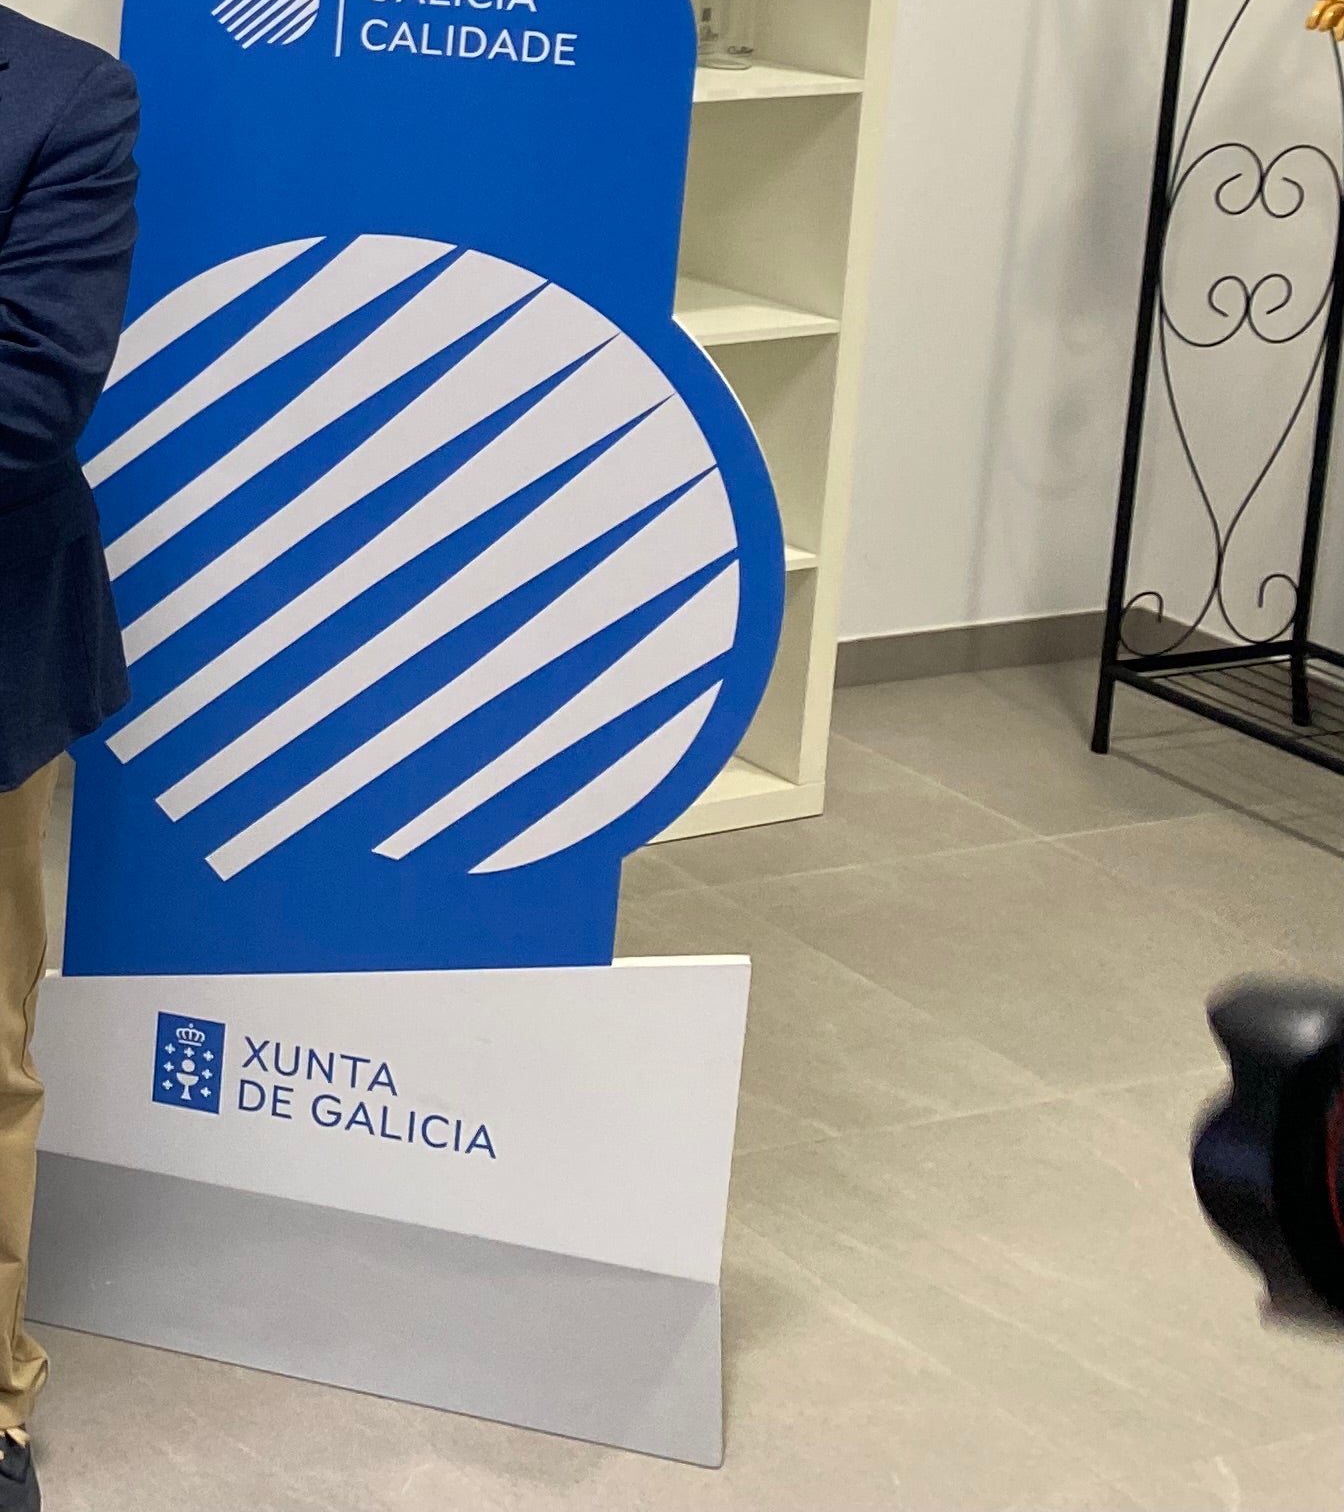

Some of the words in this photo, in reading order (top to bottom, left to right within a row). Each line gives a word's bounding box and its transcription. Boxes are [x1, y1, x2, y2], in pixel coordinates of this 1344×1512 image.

[360, 18, 578, 66] CALIDADE
[241, 1035, 398, 1097] XUNTA
[237, 1078, 295, 1120] DE
[311, 1093, 497, 1160] GALICIA
